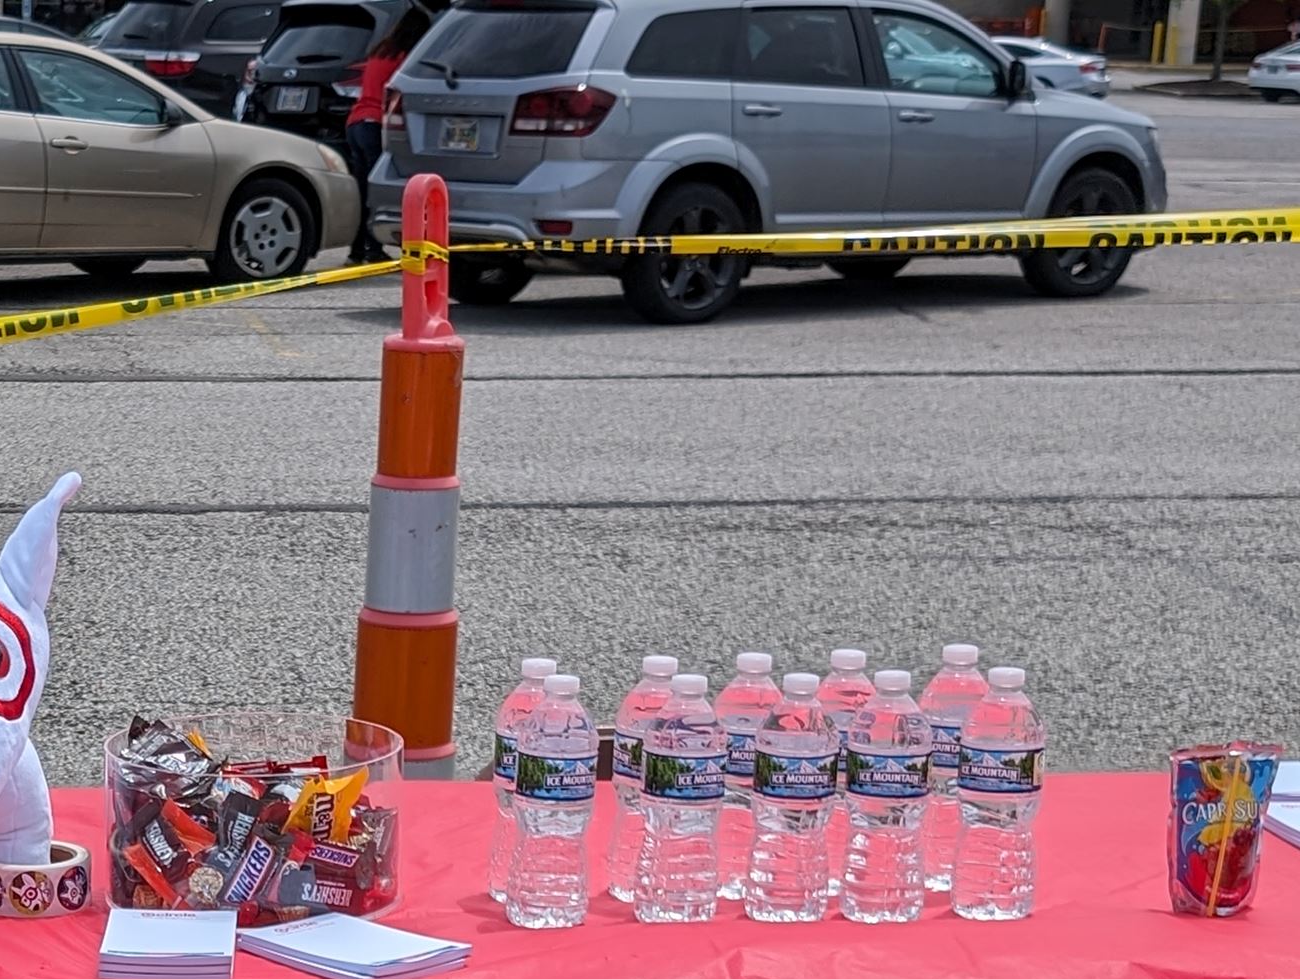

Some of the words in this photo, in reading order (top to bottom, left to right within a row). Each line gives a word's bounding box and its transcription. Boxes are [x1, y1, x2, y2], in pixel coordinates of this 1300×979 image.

[860, 771, 872, 781] ICE
[971, 766, 1018, 780] MOUNTAIN
[546, 775, 561, 786] ICE
[678, 775, 693, 785] ICE
[772, 774, 785, 784] ICE
[301, 883, 353, 907] HERSHEY'S
